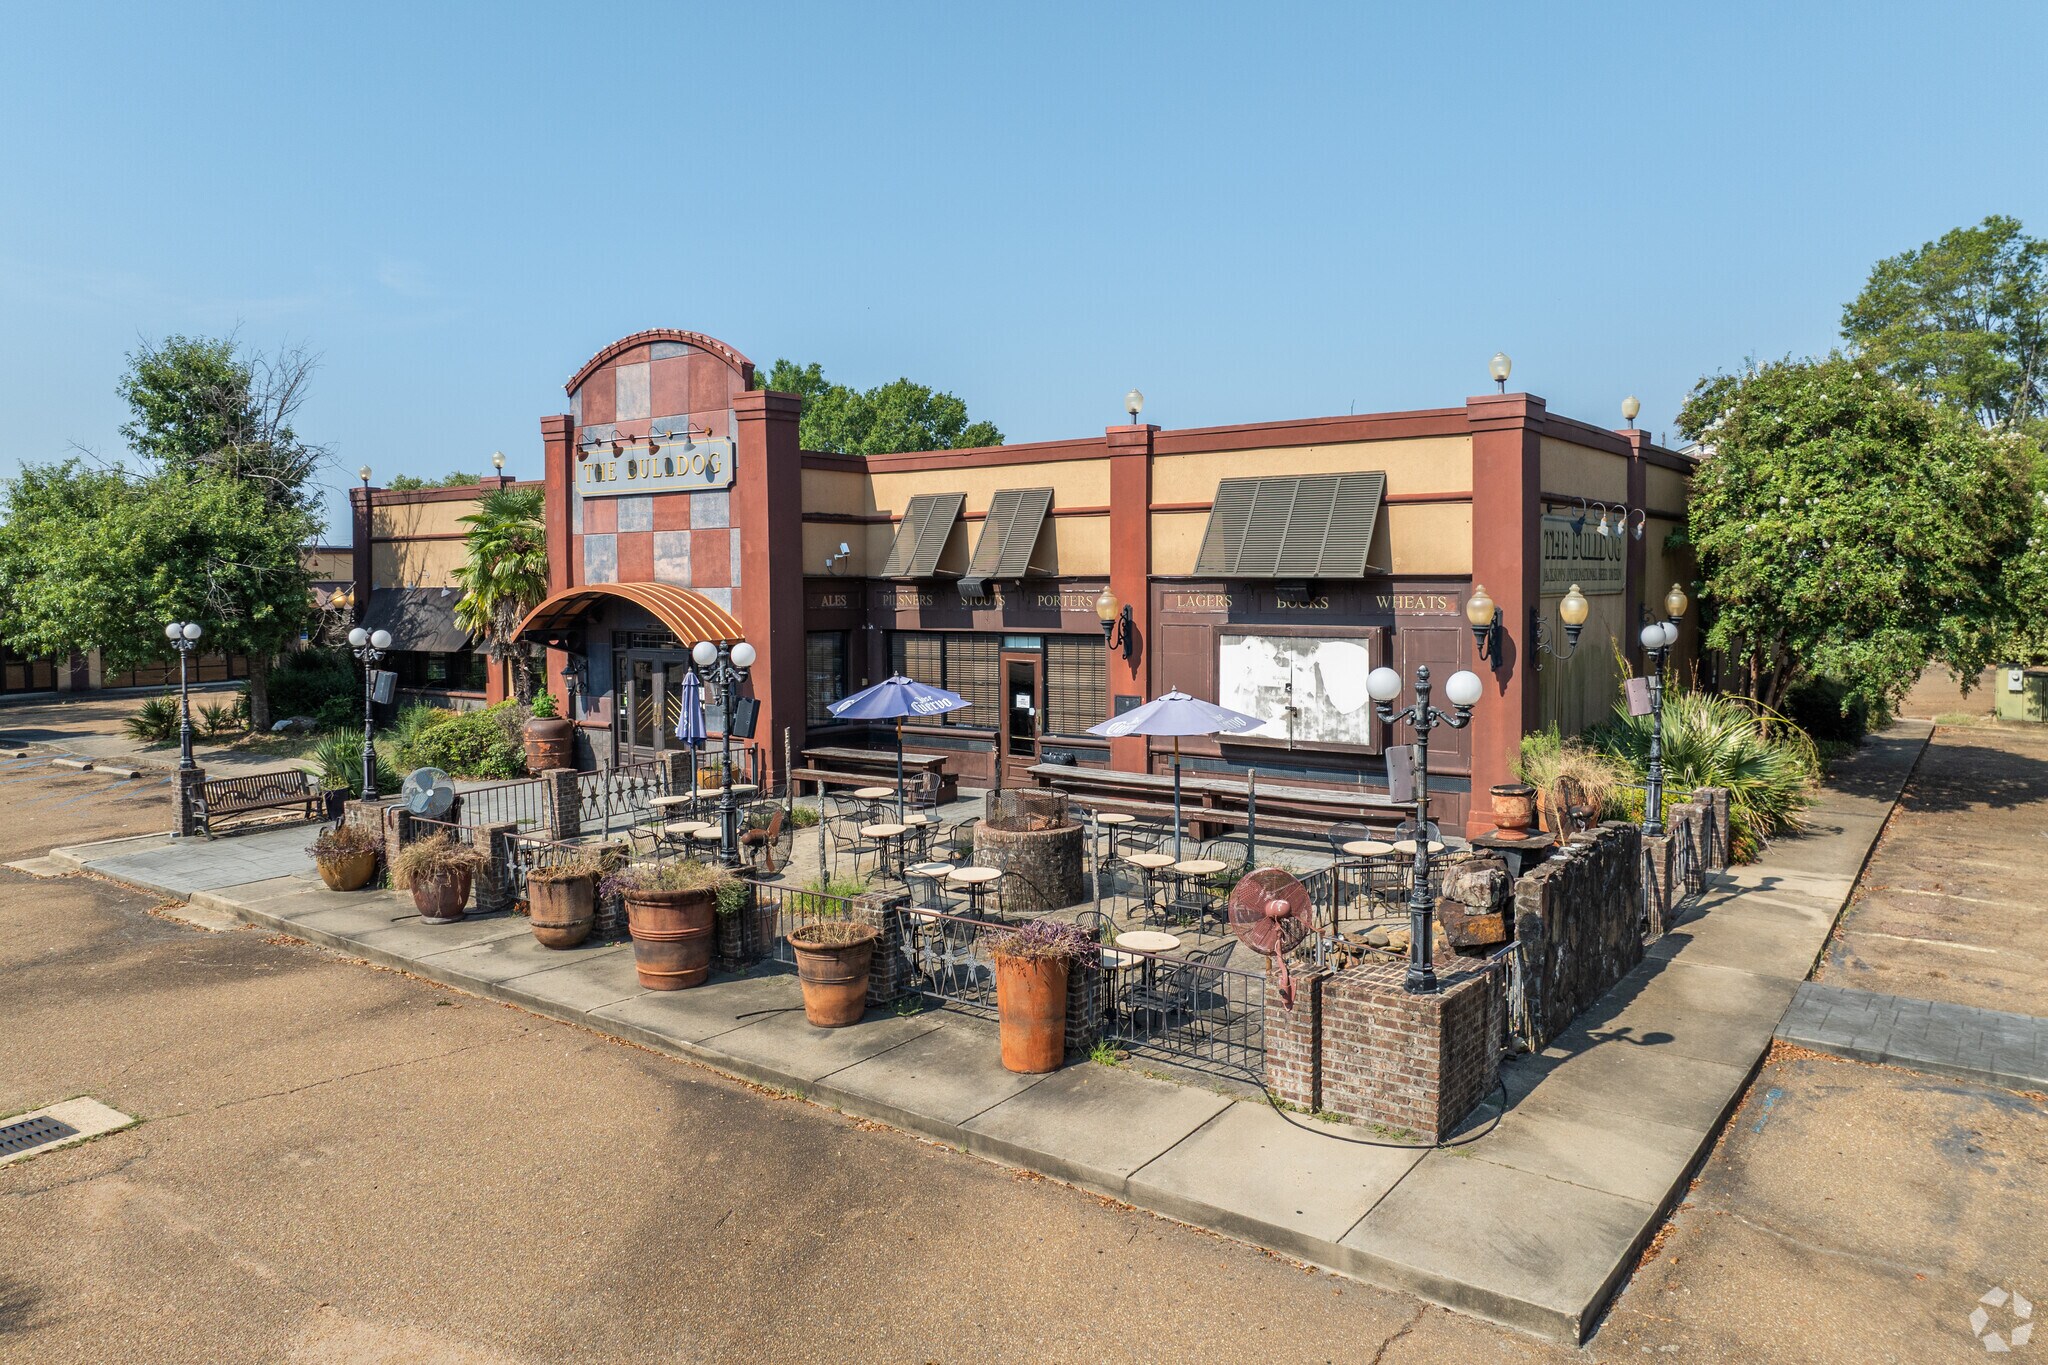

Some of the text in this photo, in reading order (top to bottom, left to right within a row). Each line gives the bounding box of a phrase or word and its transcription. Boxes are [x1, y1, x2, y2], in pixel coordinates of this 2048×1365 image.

[583, 452, 722, 483] THE BULLDOG
[1543, 529, 1622, 562] THE BULLDOG
[821, 595, 847, 607] ALES
[883, 594, 933, 606] PILSNERS
[961, 595, 1006, 606] STOUTS
[1037, 595, 1093, 607] PORTERS
[1176, 595, 1233, 607] LAGERS
[1376, 595, 1447, 609] WHEATS
[910, 697, 953, 715] Cuervo
